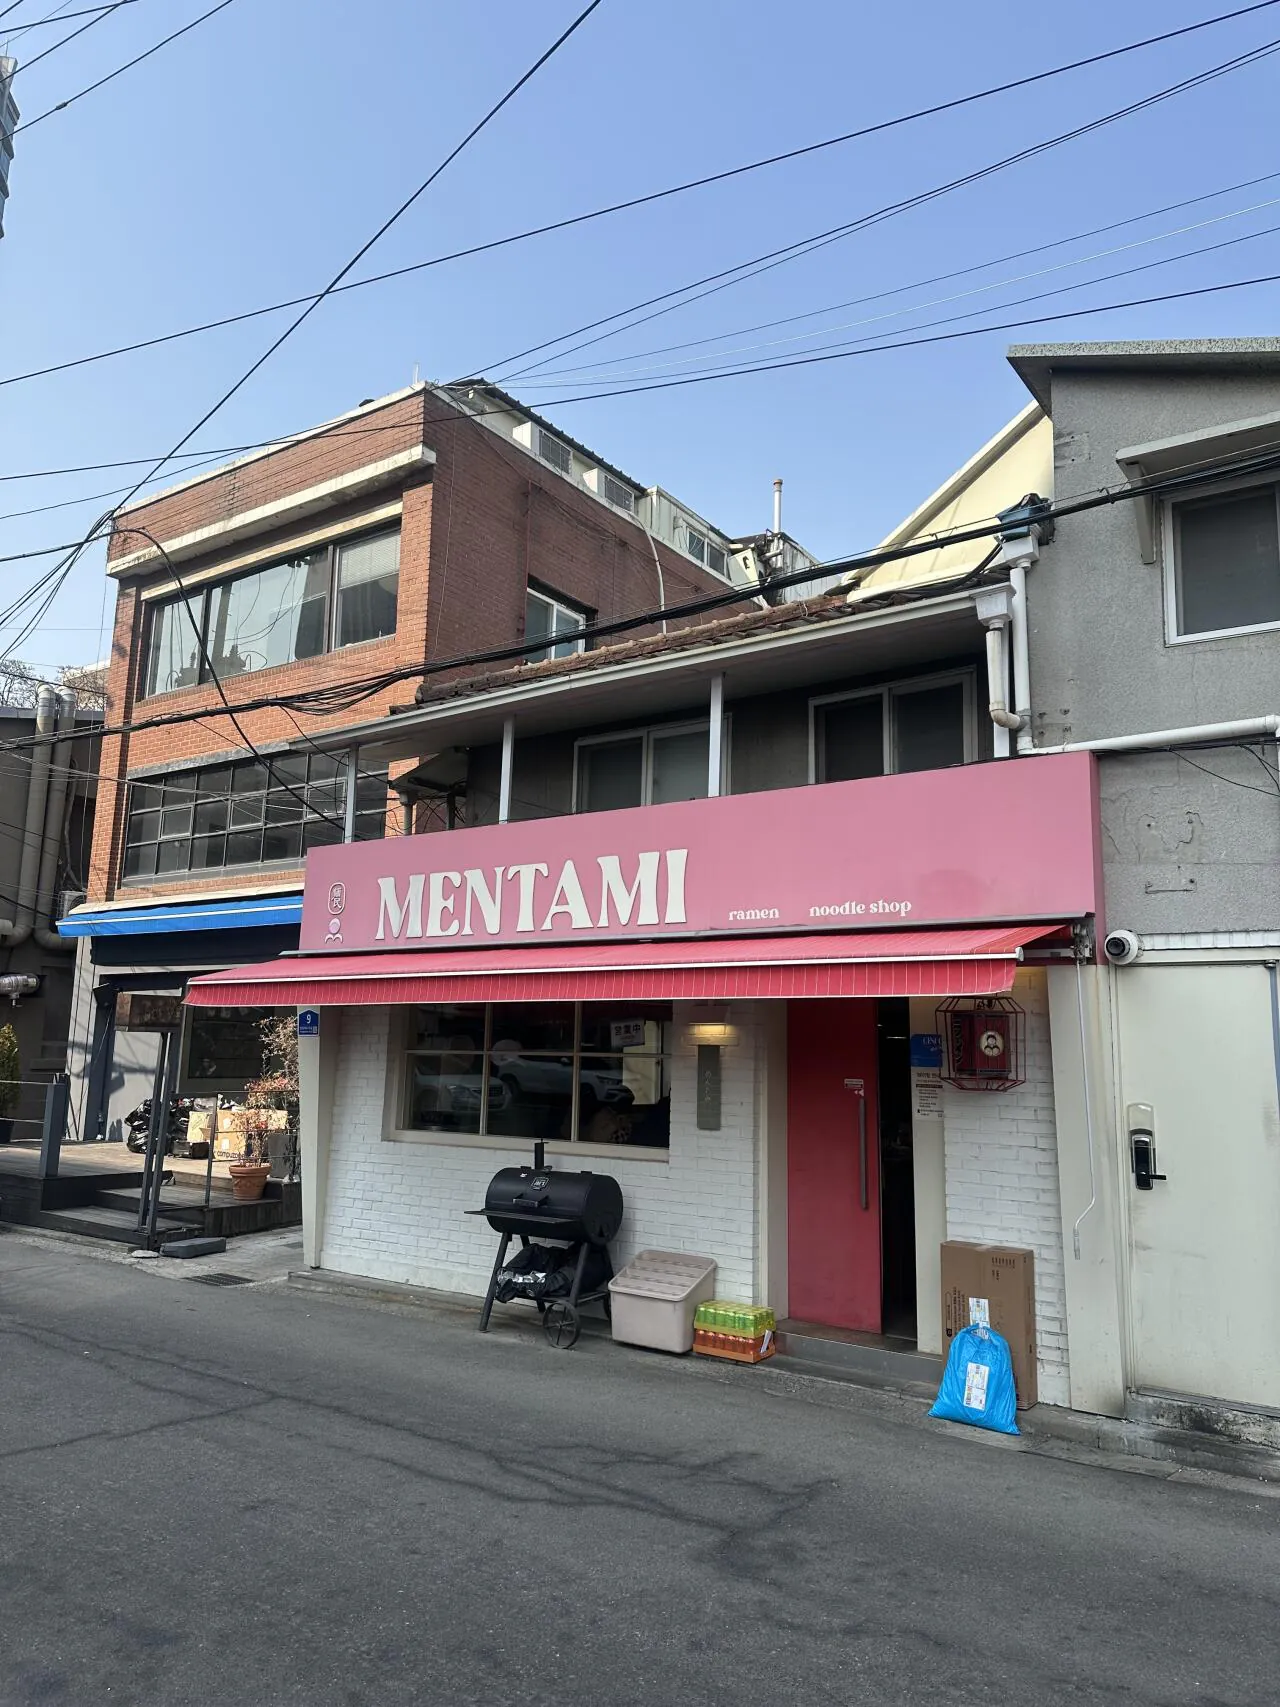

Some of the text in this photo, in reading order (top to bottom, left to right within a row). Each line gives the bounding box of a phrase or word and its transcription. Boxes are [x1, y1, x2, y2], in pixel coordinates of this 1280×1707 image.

[375, 849, 688, 940] MENTAMI
[729, 908, 780, 920] ramen
[809, 899, 912, 917] noodle shop
[306, 1014, 312, 1024] 9
